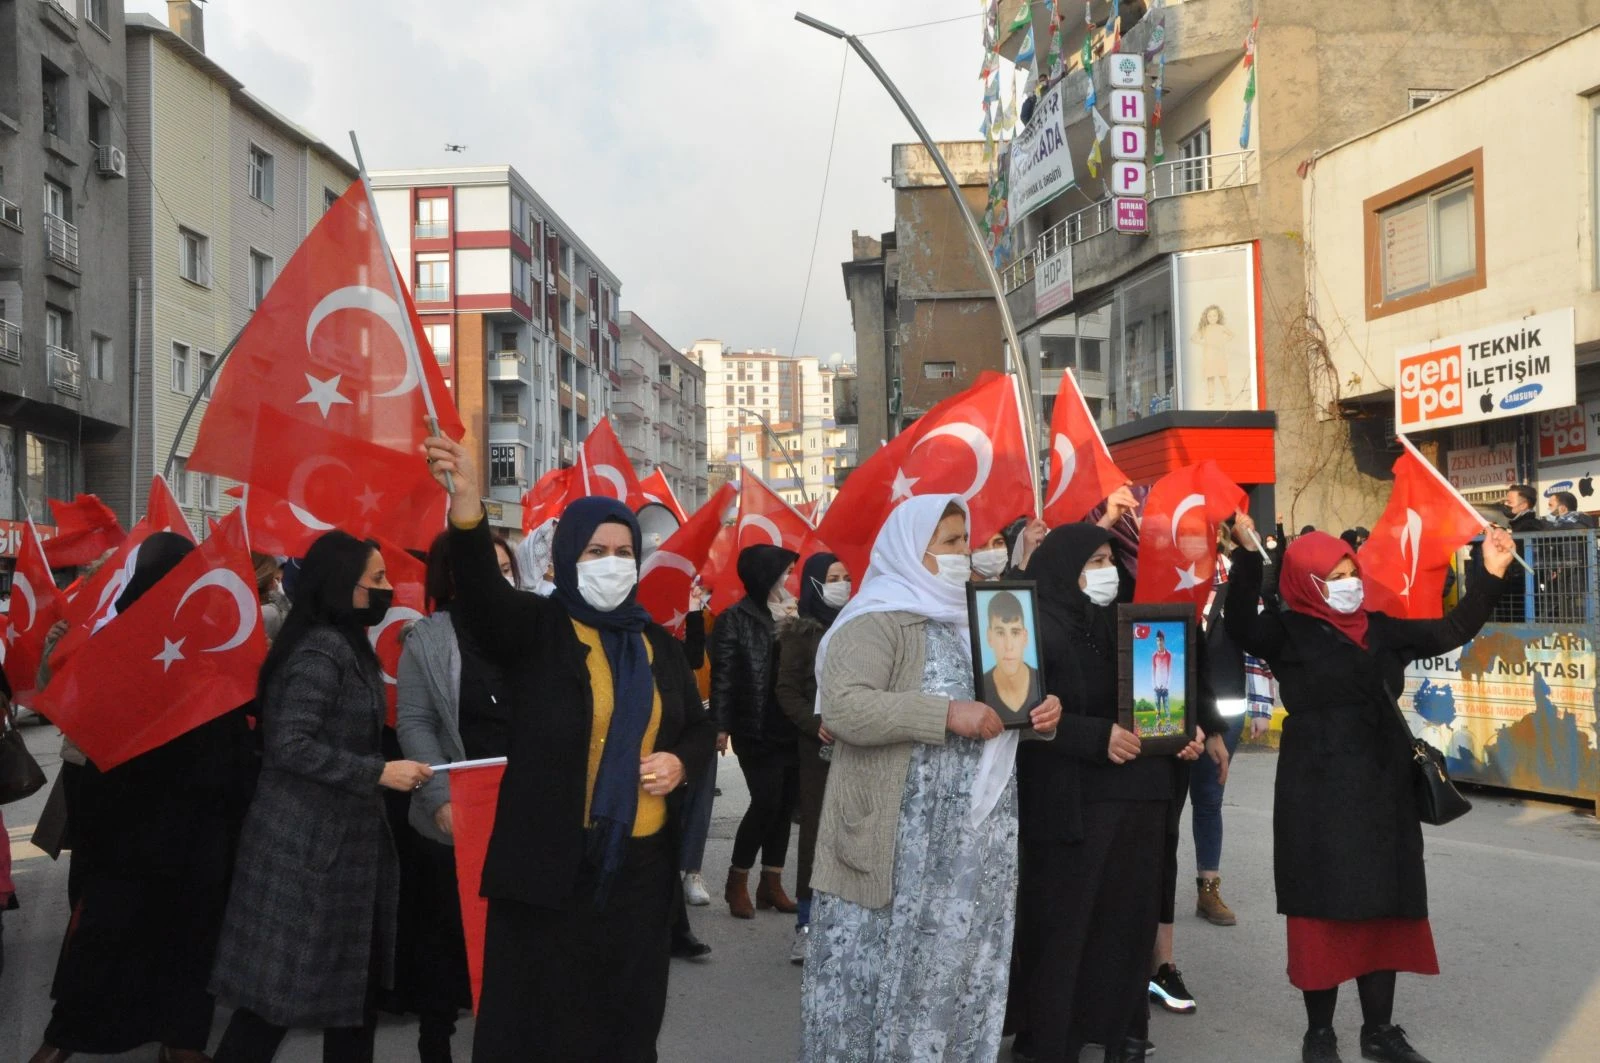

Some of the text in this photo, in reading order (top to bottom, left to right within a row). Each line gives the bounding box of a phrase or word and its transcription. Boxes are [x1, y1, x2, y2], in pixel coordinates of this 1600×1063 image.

[1043, 259, 1062, 288] HDP
[1468, 328, 1541, 360] TEKNİK
[1401, 355, 1460, 399] gen
[1467, 354, 1550, 389] İLETİŞİM
[1419, 382, 1460, 422] pa
[1504, 390, 1538, 403] SAMSUNG
[1498, 661, 1586, 680] NOKTASI
